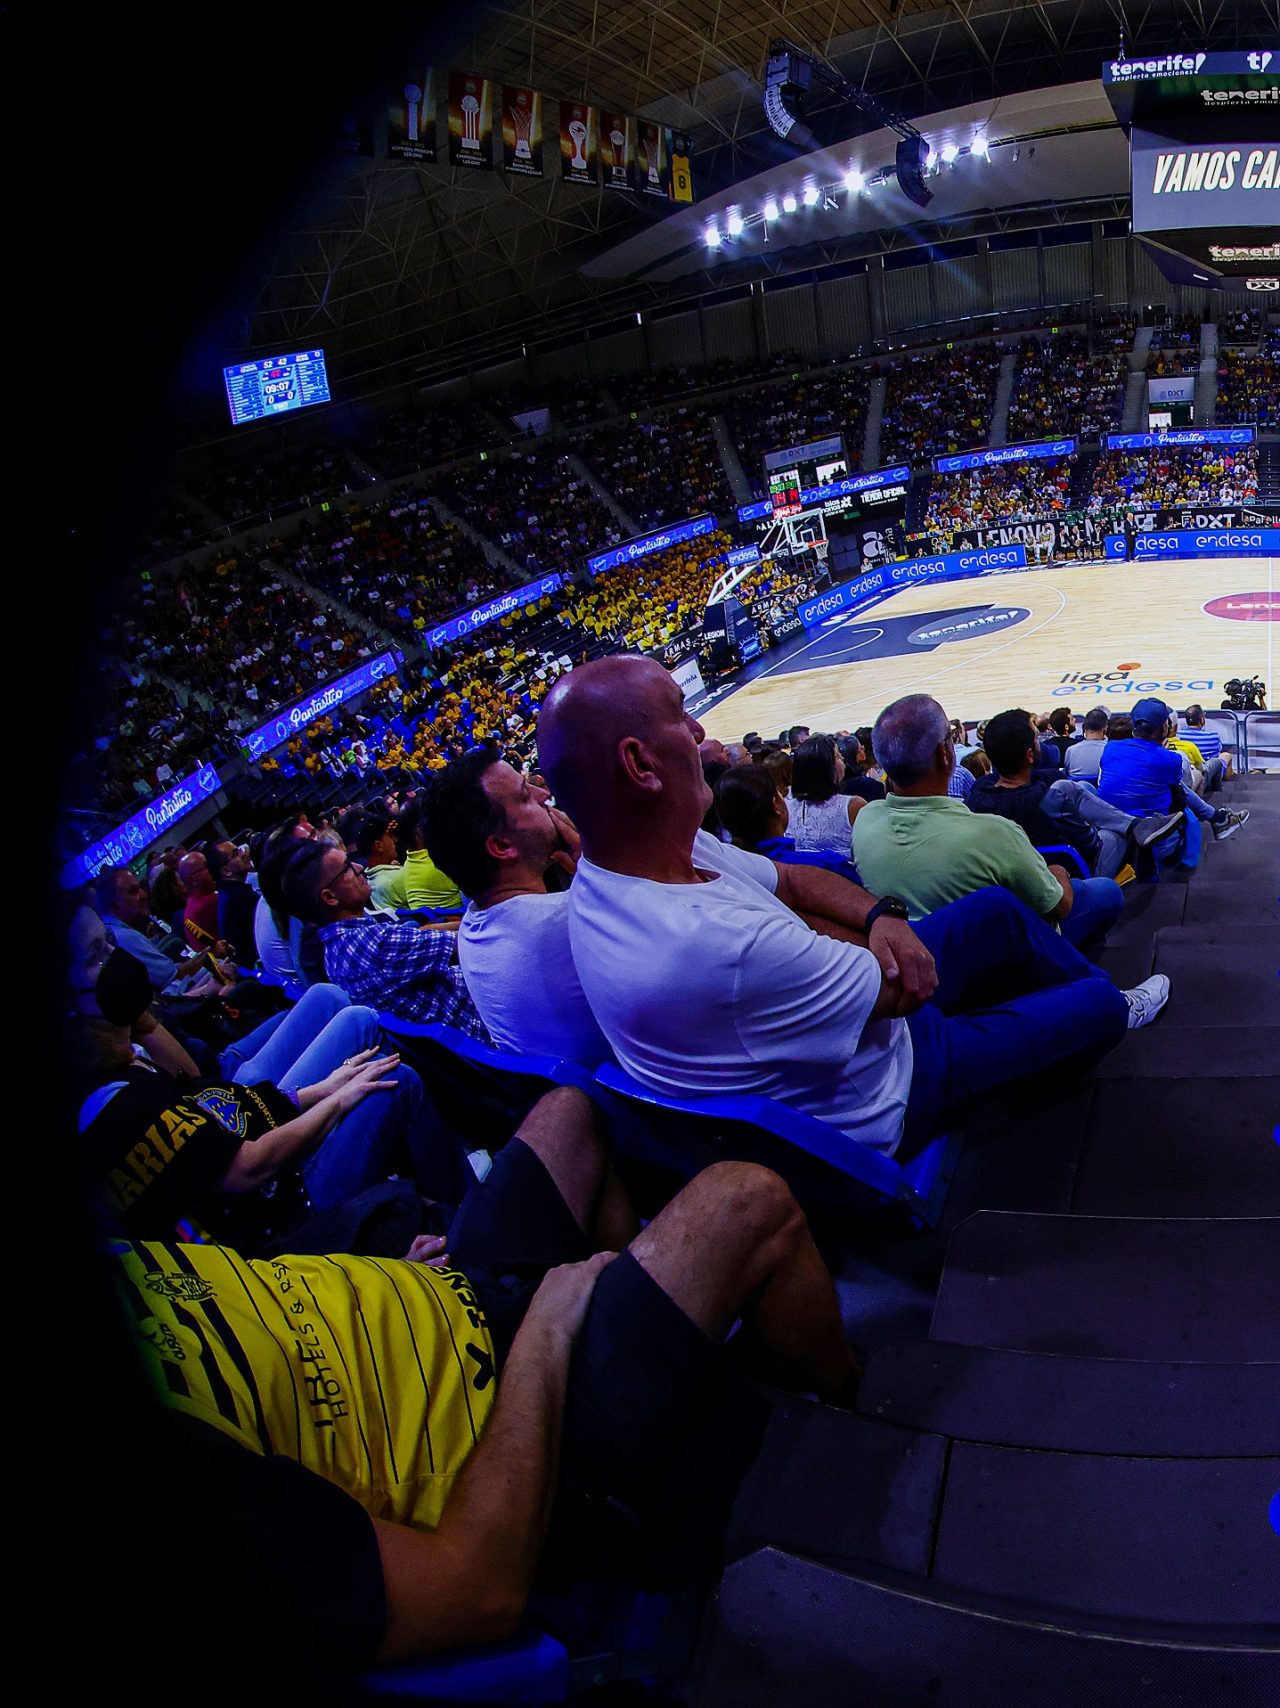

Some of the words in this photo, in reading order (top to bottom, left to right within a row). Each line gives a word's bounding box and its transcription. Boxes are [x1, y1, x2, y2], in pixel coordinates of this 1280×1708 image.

[1110, 52, 1206, 76] tenerife!
[1112, 73, 1149, 82] despierta
[1152, 70, 1193, 78] emociones
[1152, 150, 1241, 194] VAMOS
[265, 381, 290, 394] 09:07
[1195, 513, 1236, 528] DXT
[1114, 536, 1179, 552] edesa
[1195, 533, 1262, 548] endesa
[959, 549, 1019, 569] endesa
[891, 559, 946, 580] endesa
[850, 573, 883, 598] endesa
[471, 597, 518, 625] Pantástico
[804, 593, 844, 621] endesa
[703, 628, 725, 641] LEGION
[773, 617, 801, 637] endesa
[1059, 670, 1130, 684] liga
[1051, 678, 1215, 697] endesa
[290, 686, 344, 728] Pantástico
[146, 786, 193, 832] Pantástico
[113, 1099, 207, 1208] ARIAS
[290, 1299, 305, 1316] &
[297, 1322, 350, 1419] HOTELS
